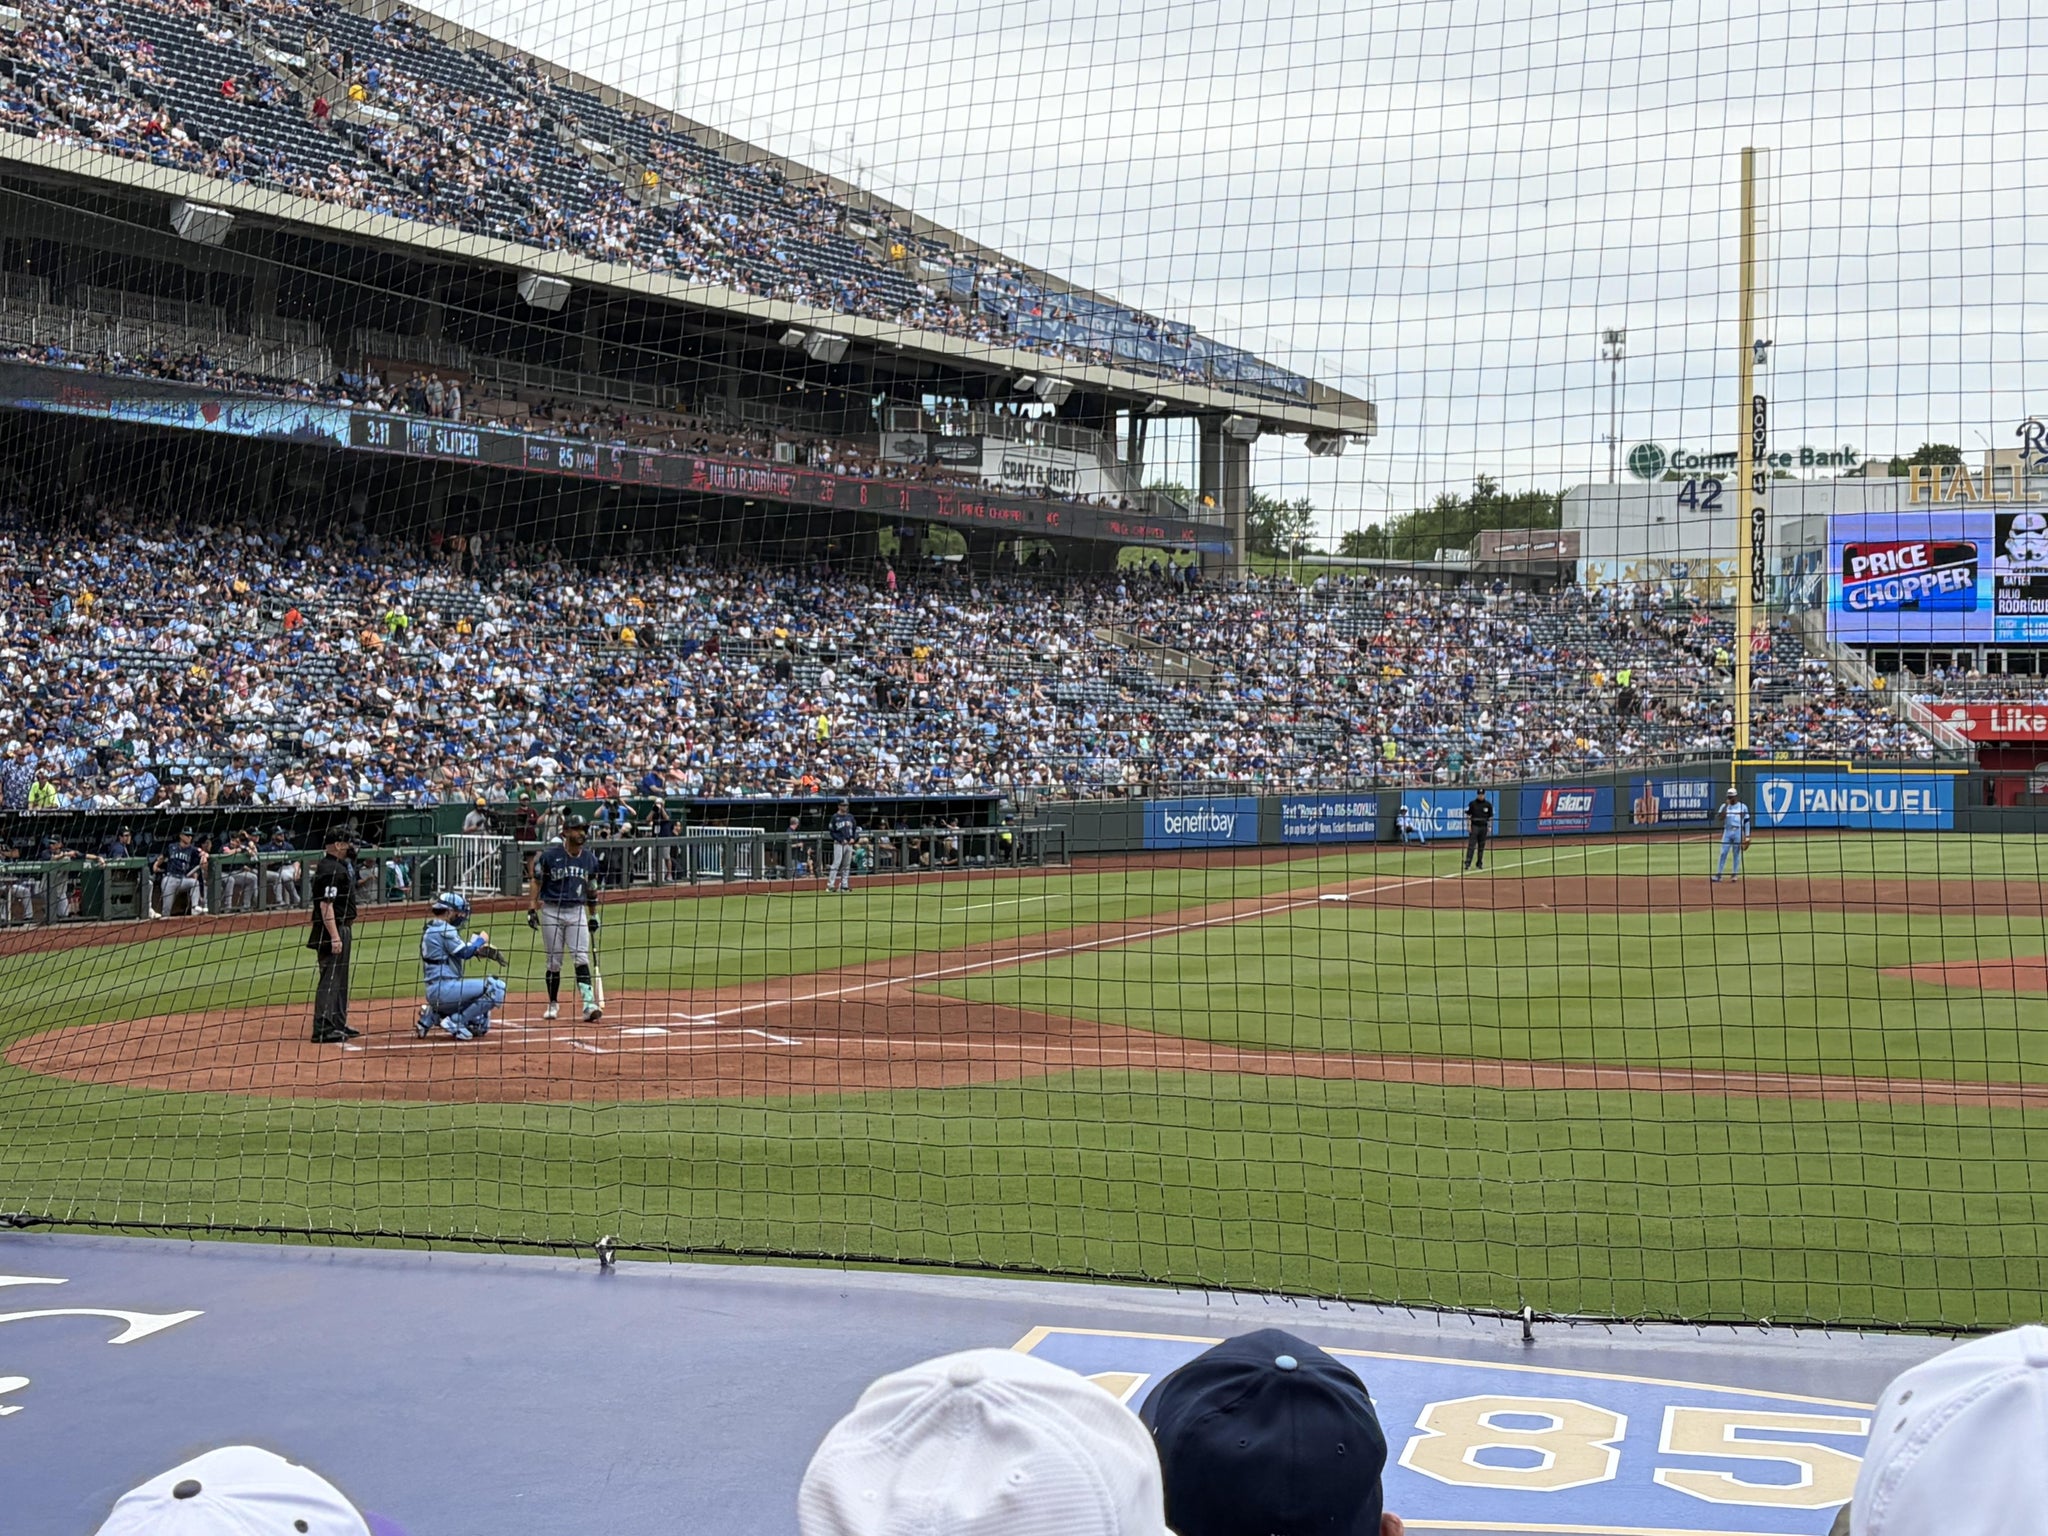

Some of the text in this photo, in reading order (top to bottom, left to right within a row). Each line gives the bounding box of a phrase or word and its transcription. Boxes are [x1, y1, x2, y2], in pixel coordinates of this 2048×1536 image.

[367, 420, 391, 446] 3:11
[435, 428, 478, 458] SLIDER
[558, 446, 575, 470] 85
[575, 451, 595, 472] MPH
[1671, 446, 1857, 470] Commce Bank
[709, 463, 738, 490] JULIO
[1002, 460, 1076, 489] CRAFT & DRAFT
[1908, 464, 2042, 504] HALL
[1676, 478, 1723, 510] 42
[1851, 543, 1928, 580] PRICE
[1848, 567, 1973, 611] CHOPPER
[1998, 588, 2021, 599] JULIO
[1991, 708, 2048, 733] Like
[1800, 788, 1942, 816] FANDUEL
